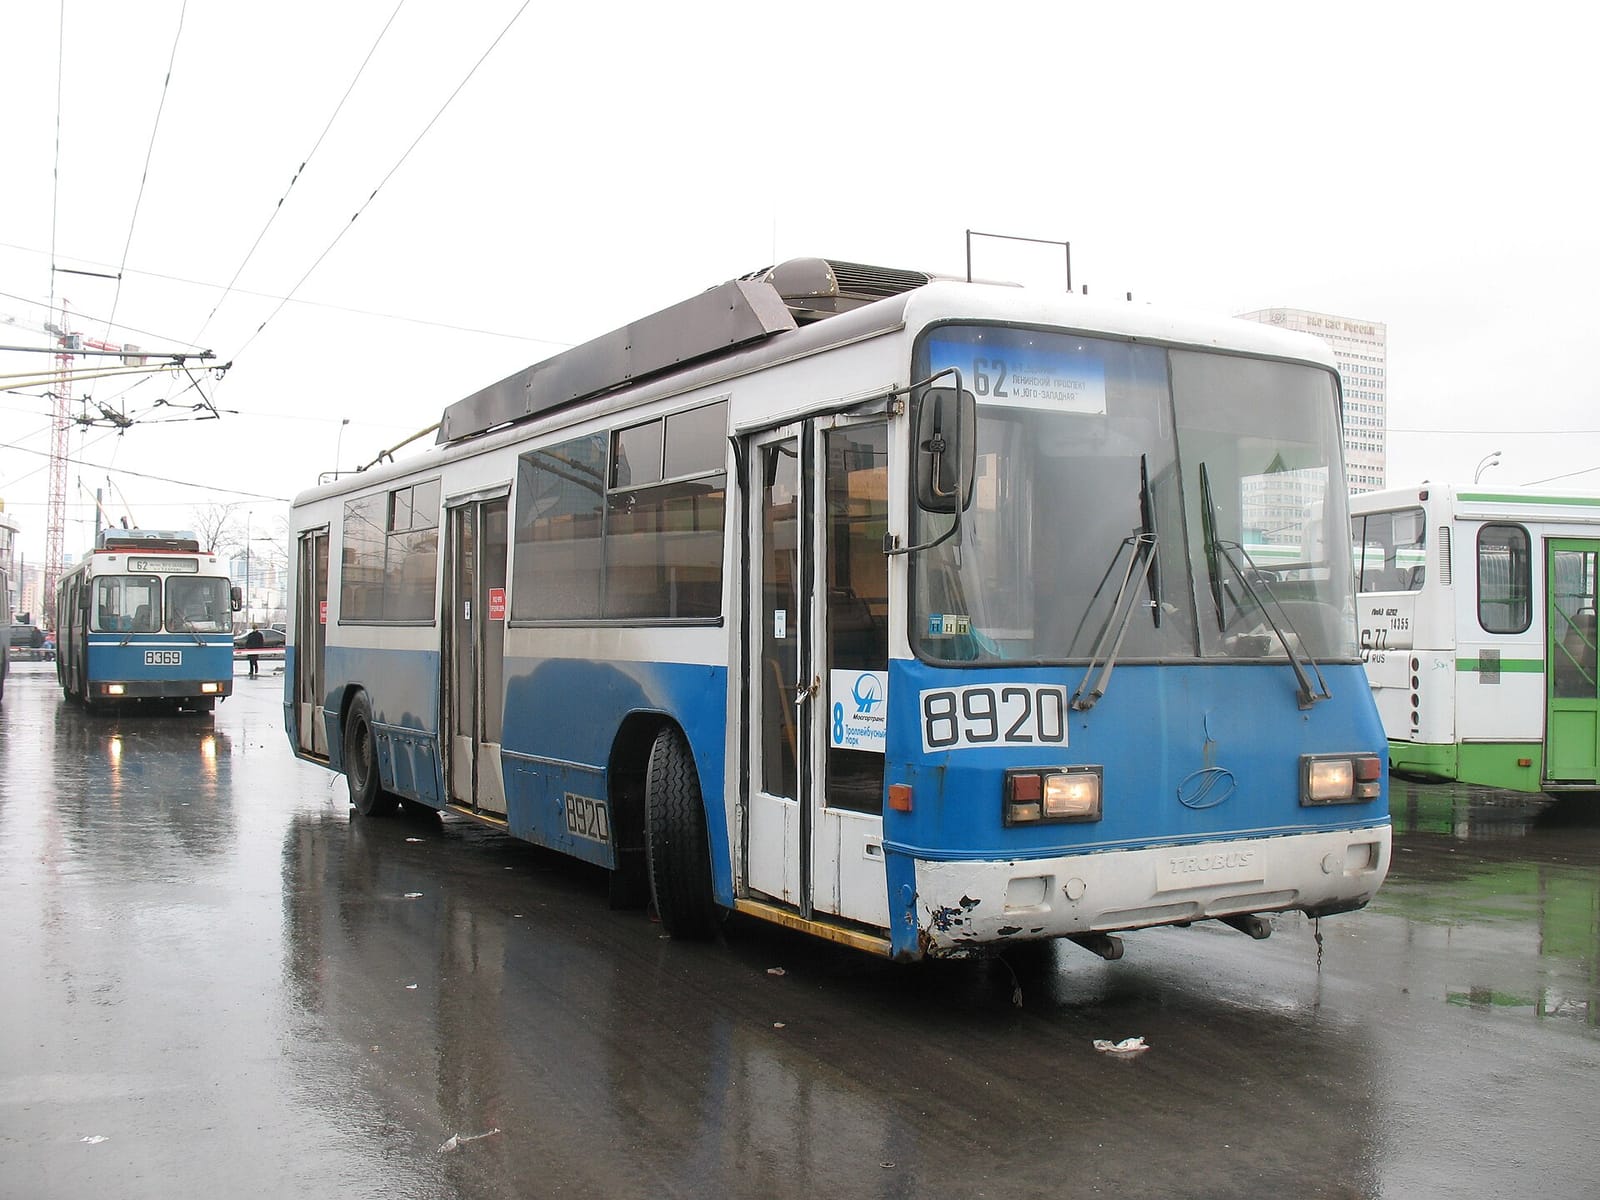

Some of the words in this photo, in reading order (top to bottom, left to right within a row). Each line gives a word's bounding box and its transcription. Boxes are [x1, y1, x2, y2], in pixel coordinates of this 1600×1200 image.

[973, 357, 1008, 398] 62
[137, 561, 148, 570] 62
[1390, 618, 1409, 630] 14355
[1375, 629, 1387, 649] 77
[146, 651, 181, 664] 8369
[1371, 654, 1385, 663] RUS
[833, 701, 844, 745] 8
[924, 687, 1064, 748] 8920
[846, 737, 858, 746] парк
[565, 794, 609, 841] 8920
[1170, 851, 1255, 875] TROBUS
